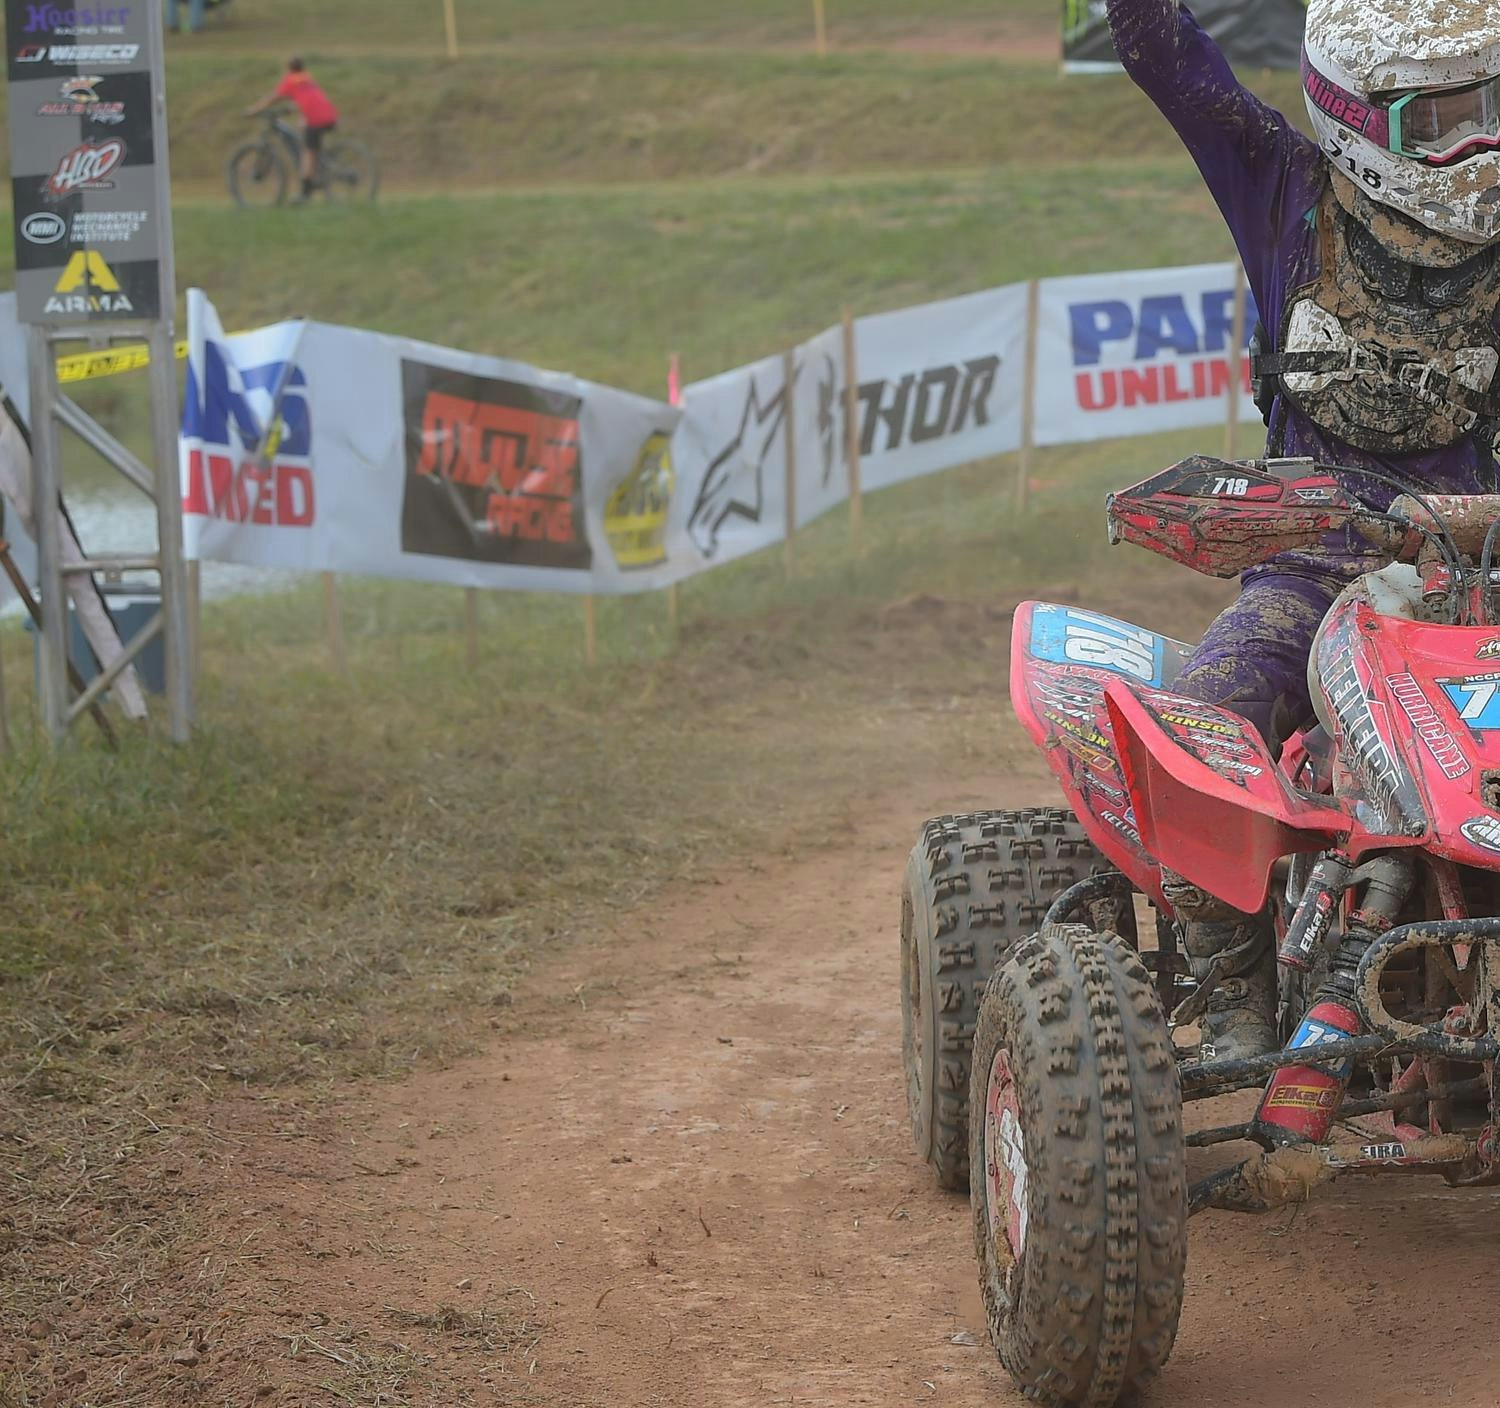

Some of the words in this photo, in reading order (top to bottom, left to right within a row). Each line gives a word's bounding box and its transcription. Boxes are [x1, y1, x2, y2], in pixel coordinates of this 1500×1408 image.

[23, 3, 130, 33] Hoosier
[1328, 138, 1382, 190] 718
[72, 223, 140, 233] MECHANICS
[73, 211, 148, 222] MOTORCYCLE
[70, 232, 132, 243] INSTITUTE
[44, 294, 134, 313] ARMA
[1069, 290, 1258, 366] PAR
[1075, 357, 1253, 412] UNLIM
[1211, 477, 1249, 496] 718
[1385, 672, 1471, 779] HURRICANE
